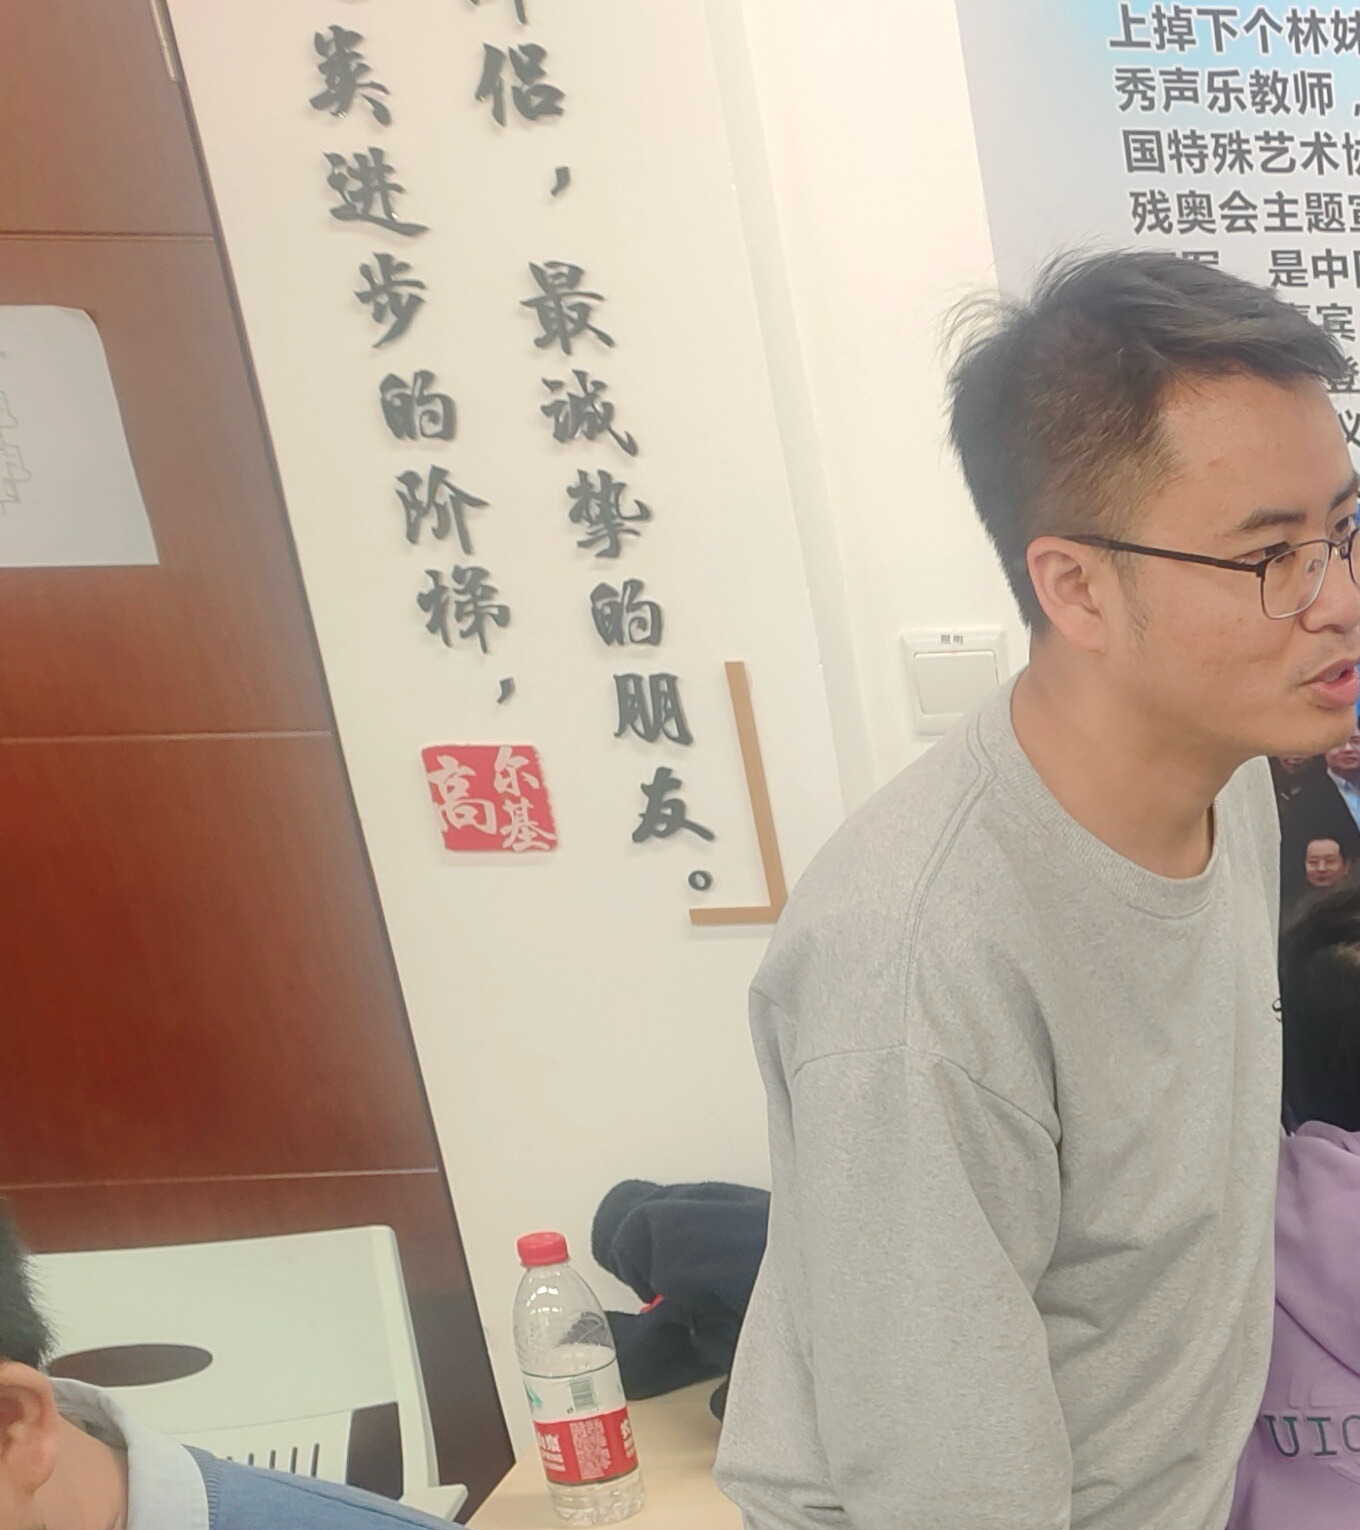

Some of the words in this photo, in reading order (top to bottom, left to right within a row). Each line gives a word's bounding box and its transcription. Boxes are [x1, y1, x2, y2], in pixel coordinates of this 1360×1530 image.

[468, 0, 715, 893] 侣，最诚挚的朋友。
